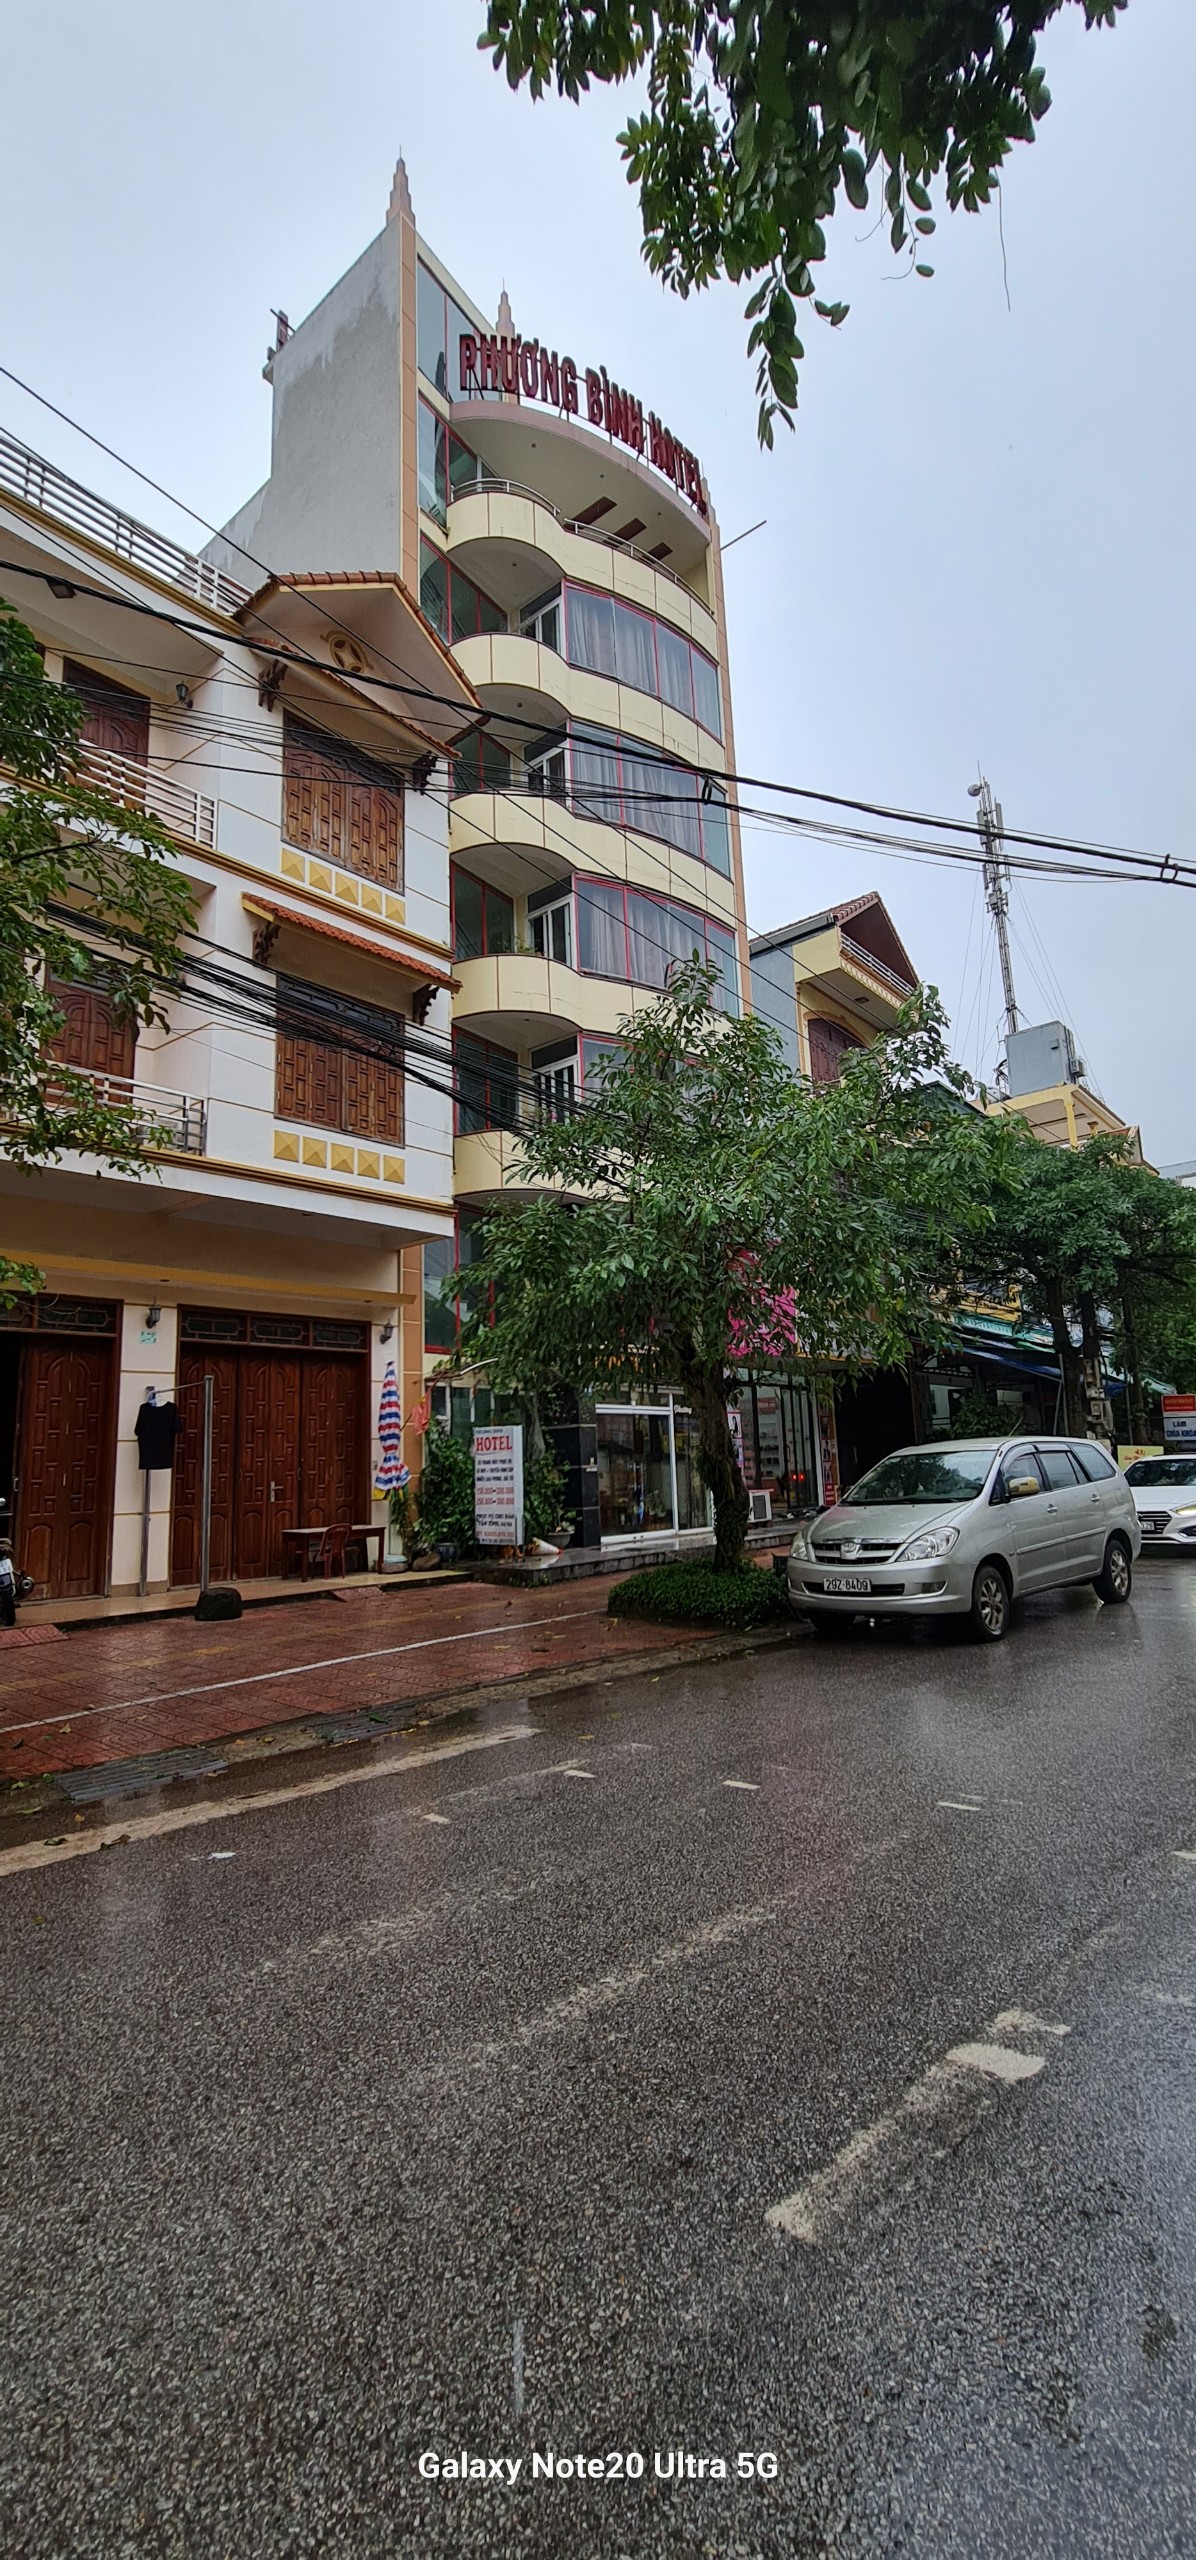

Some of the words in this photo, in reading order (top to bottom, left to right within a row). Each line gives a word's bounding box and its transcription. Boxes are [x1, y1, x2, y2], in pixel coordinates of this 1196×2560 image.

[459, 334, 578, 414] PHƯƠNG
[586, 365, 643, 455] BÌNH
[649, 410, 707, 516] HOTEL
[476, 1435, 512, 1451] HOTEL
